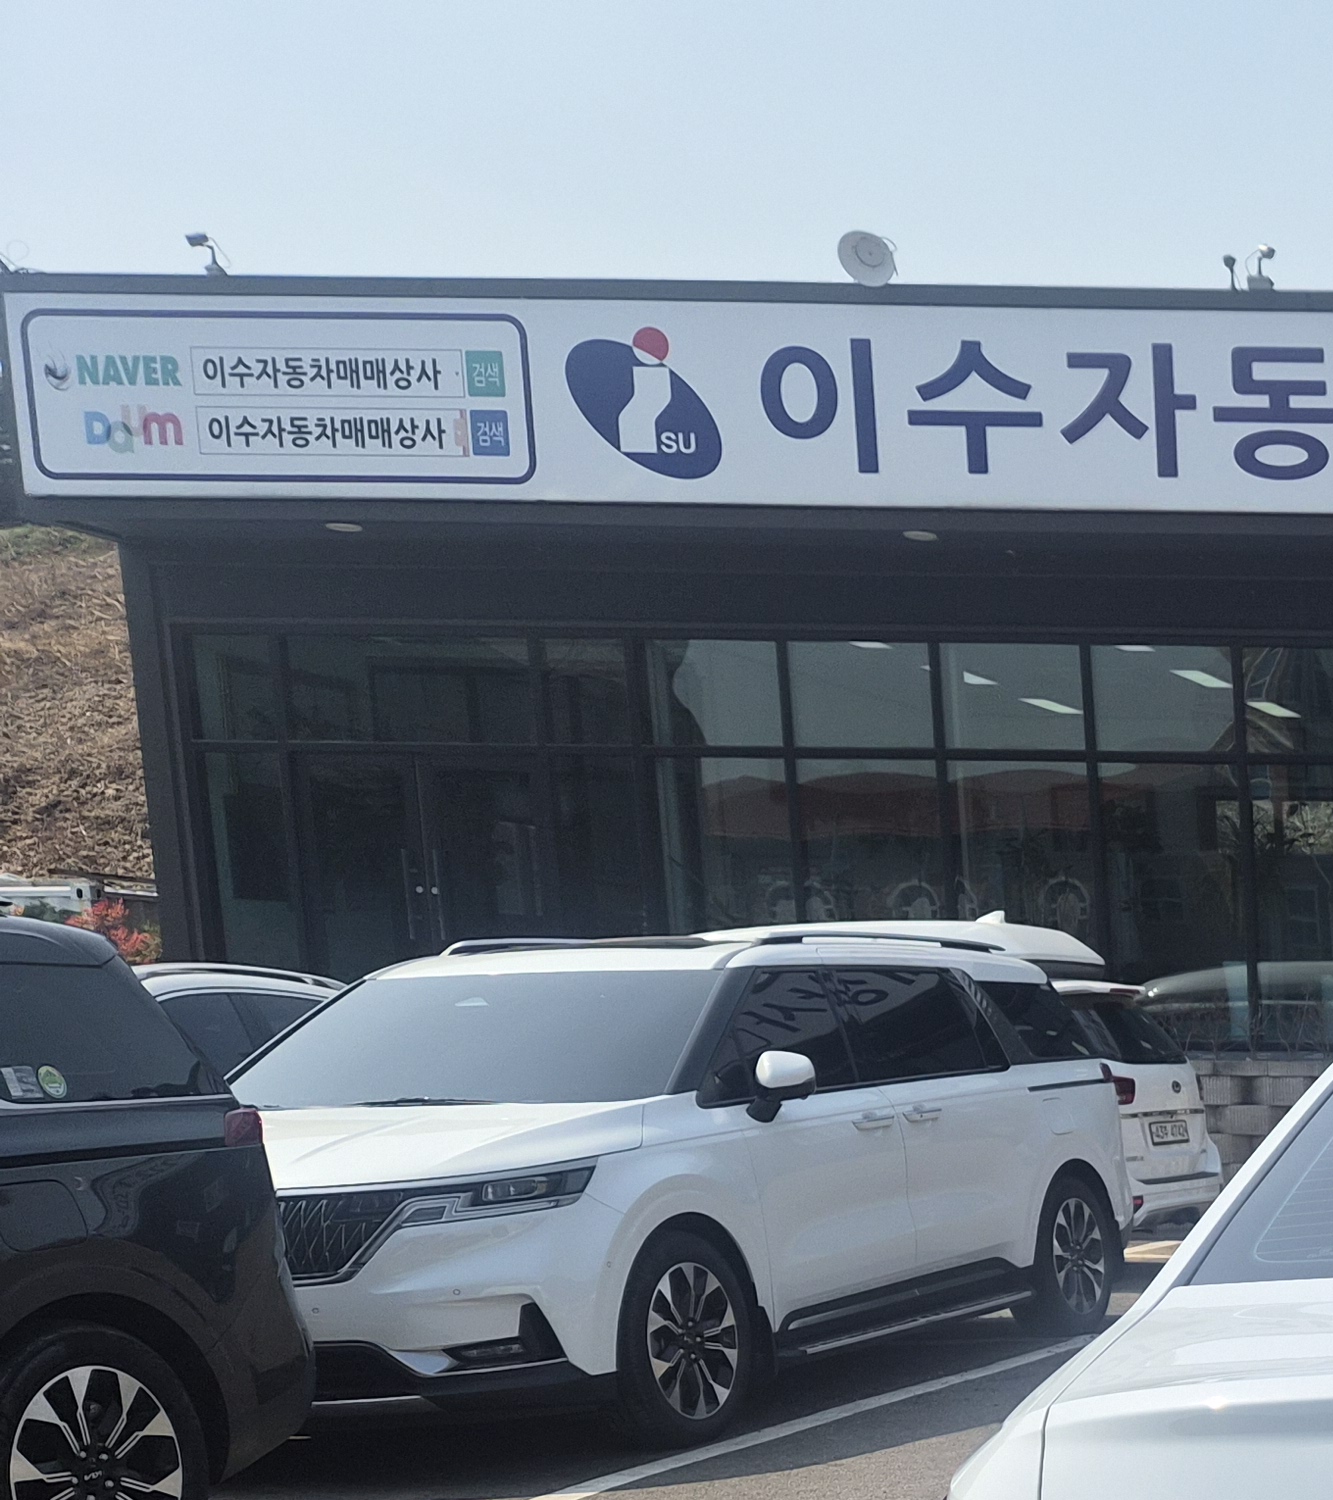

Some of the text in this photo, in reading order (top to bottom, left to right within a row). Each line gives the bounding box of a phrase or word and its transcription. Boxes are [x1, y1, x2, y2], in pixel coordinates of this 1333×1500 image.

[75, 354, 182, 387] NAVER
[202, 355, 441, 391] 이수자동차매매상사
[471, 362, 500, 388] 검색
[208, 414, 447, 450] 이수자동차매매상사
[477, 422, 506, 446] 검색
[660, 431, 696, 454] SU
